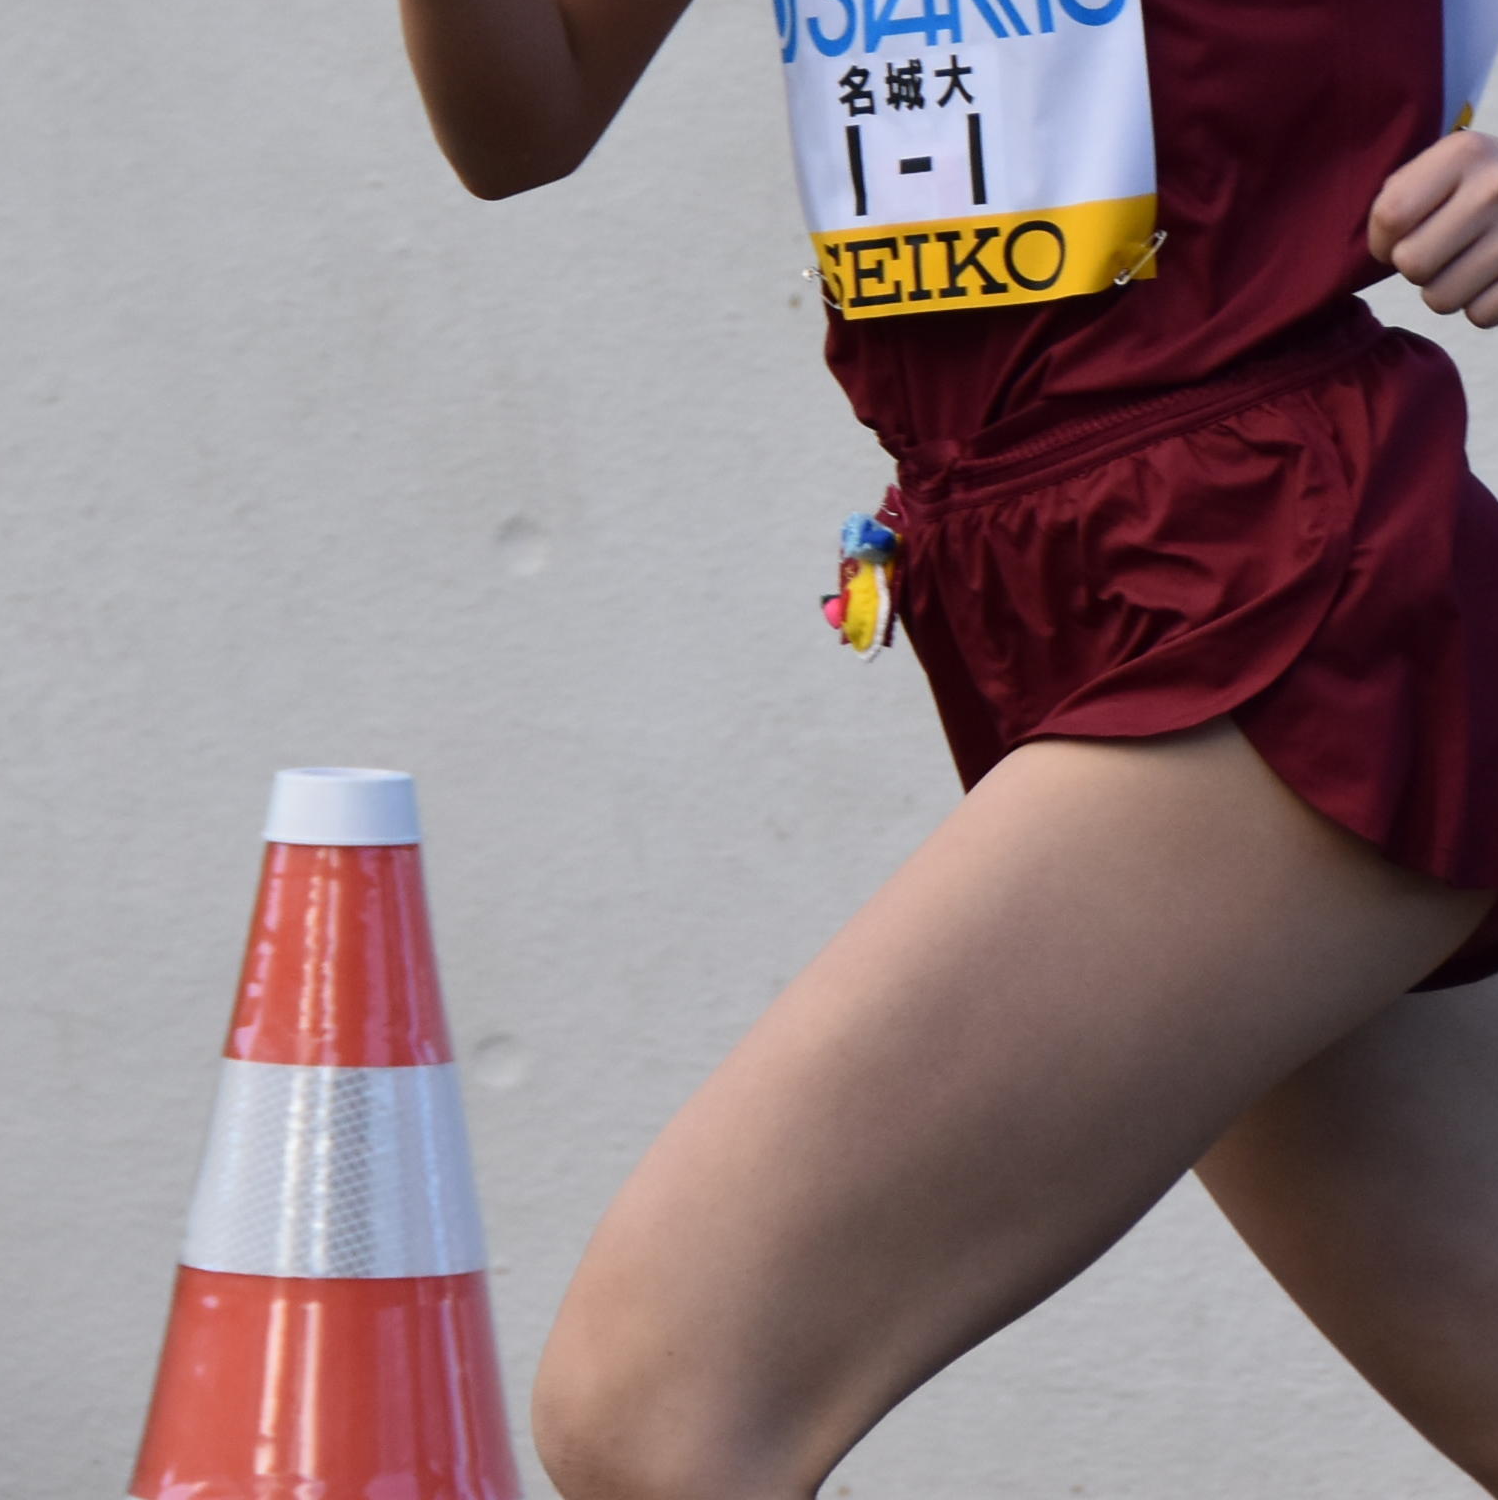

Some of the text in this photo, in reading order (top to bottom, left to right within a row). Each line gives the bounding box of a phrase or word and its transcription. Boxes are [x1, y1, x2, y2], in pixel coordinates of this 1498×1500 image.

[837, 53, 975, 118] 名城大
[844, 111, 988, 218] 1-1
